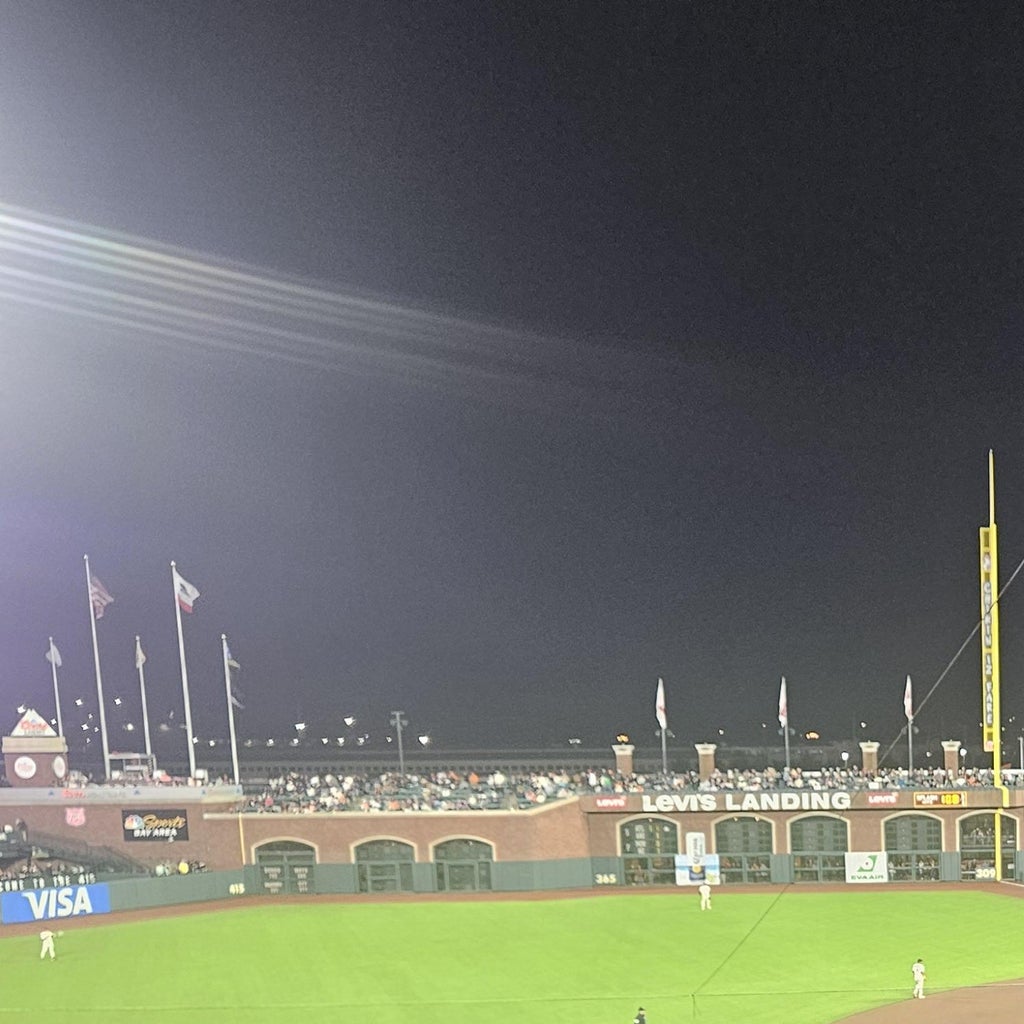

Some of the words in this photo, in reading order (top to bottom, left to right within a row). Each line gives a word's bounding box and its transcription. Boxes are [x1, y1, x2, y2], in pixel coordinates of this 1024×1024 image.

[725, 792, 851, 812] LANDING
[142, 813, 186, 829] Sports
[133, 828, 152, 837] BAY
[153, 827, 177, 836] AREA
[596, 874, 616, 884] 365
[975, 868, 996, 878] 309
[21, 886, 93, 920] VISA
